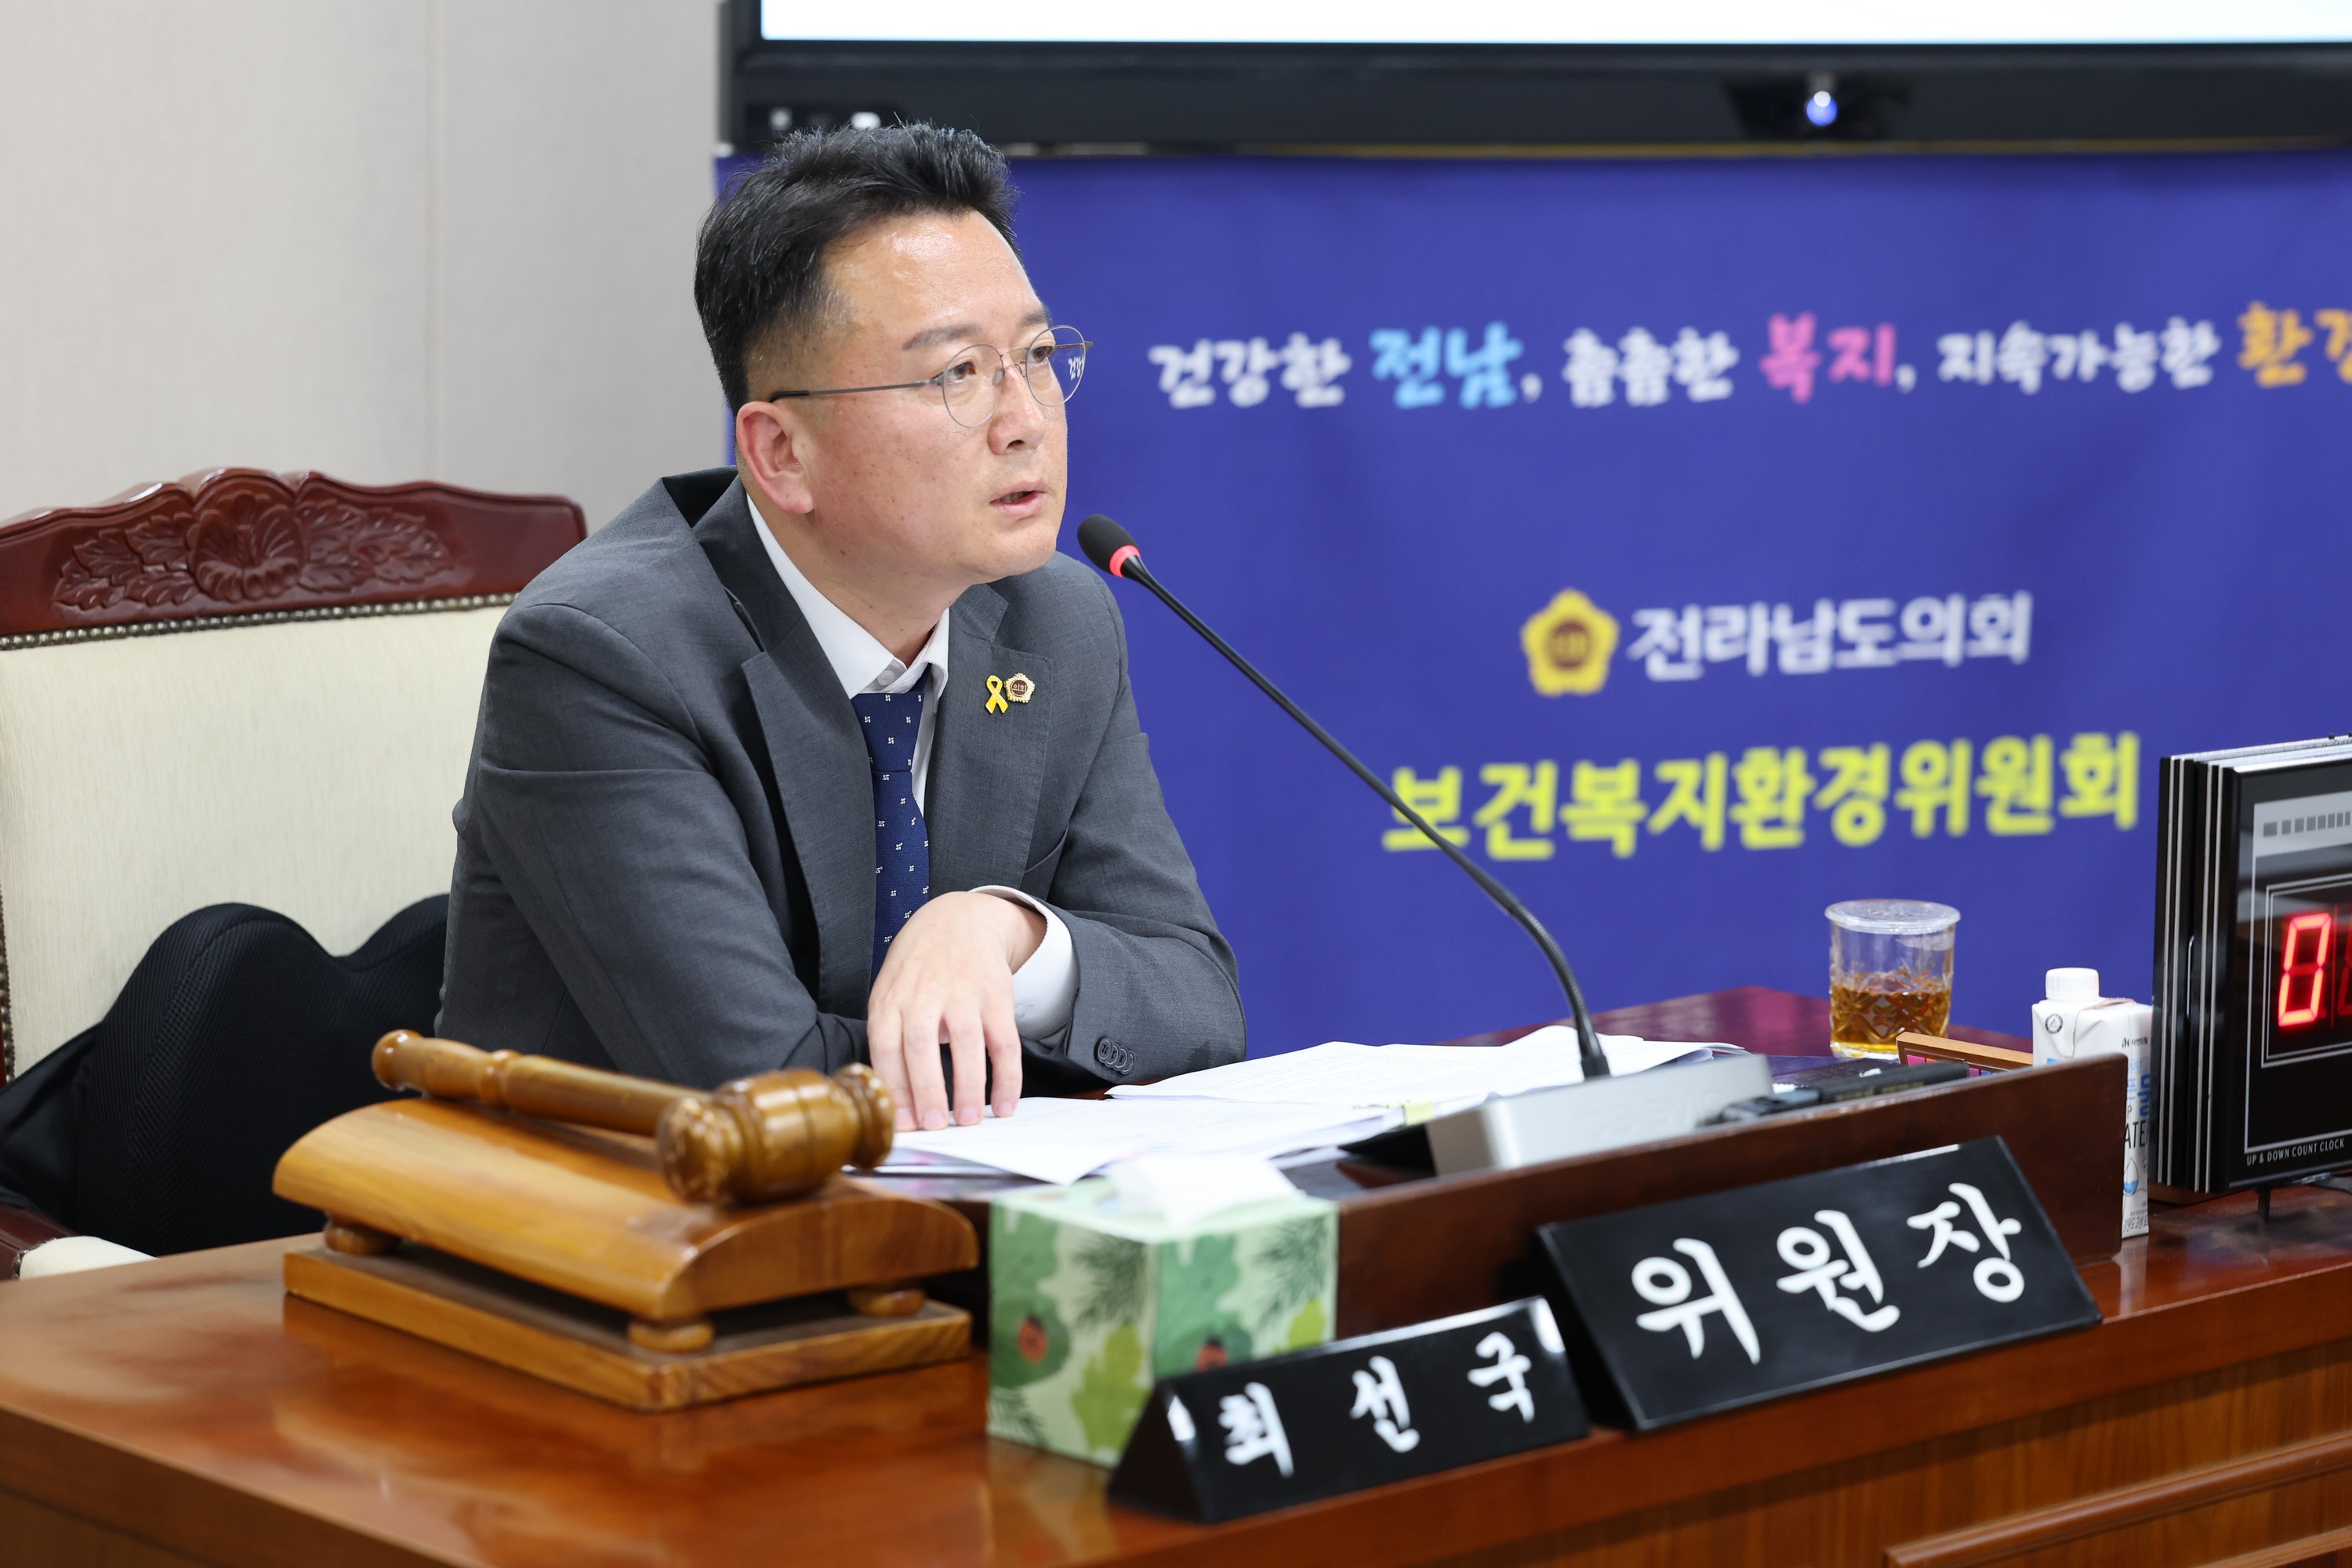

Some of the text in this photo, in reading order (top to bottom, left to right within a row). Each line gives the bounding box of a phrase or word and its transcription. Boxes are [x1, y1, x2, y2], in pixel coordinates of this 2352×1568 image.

[1149, 332, 1351, 408] 건강한
[1937, 317, 2220, 394] 지속가능한
[1628, 591, 2033, 681] 전라남도의회
[1381, 731, 2139, 860] 보건복지환경위원회
[2124, 1120, 2148, 1149] ATE
[2247, 1138, 2345, 1167] UP & DOWN COUNT CLOCK
[1632, 1182, 2024, 1364] 위원장
[1218, 1331, 1535, 1476] 최선국
